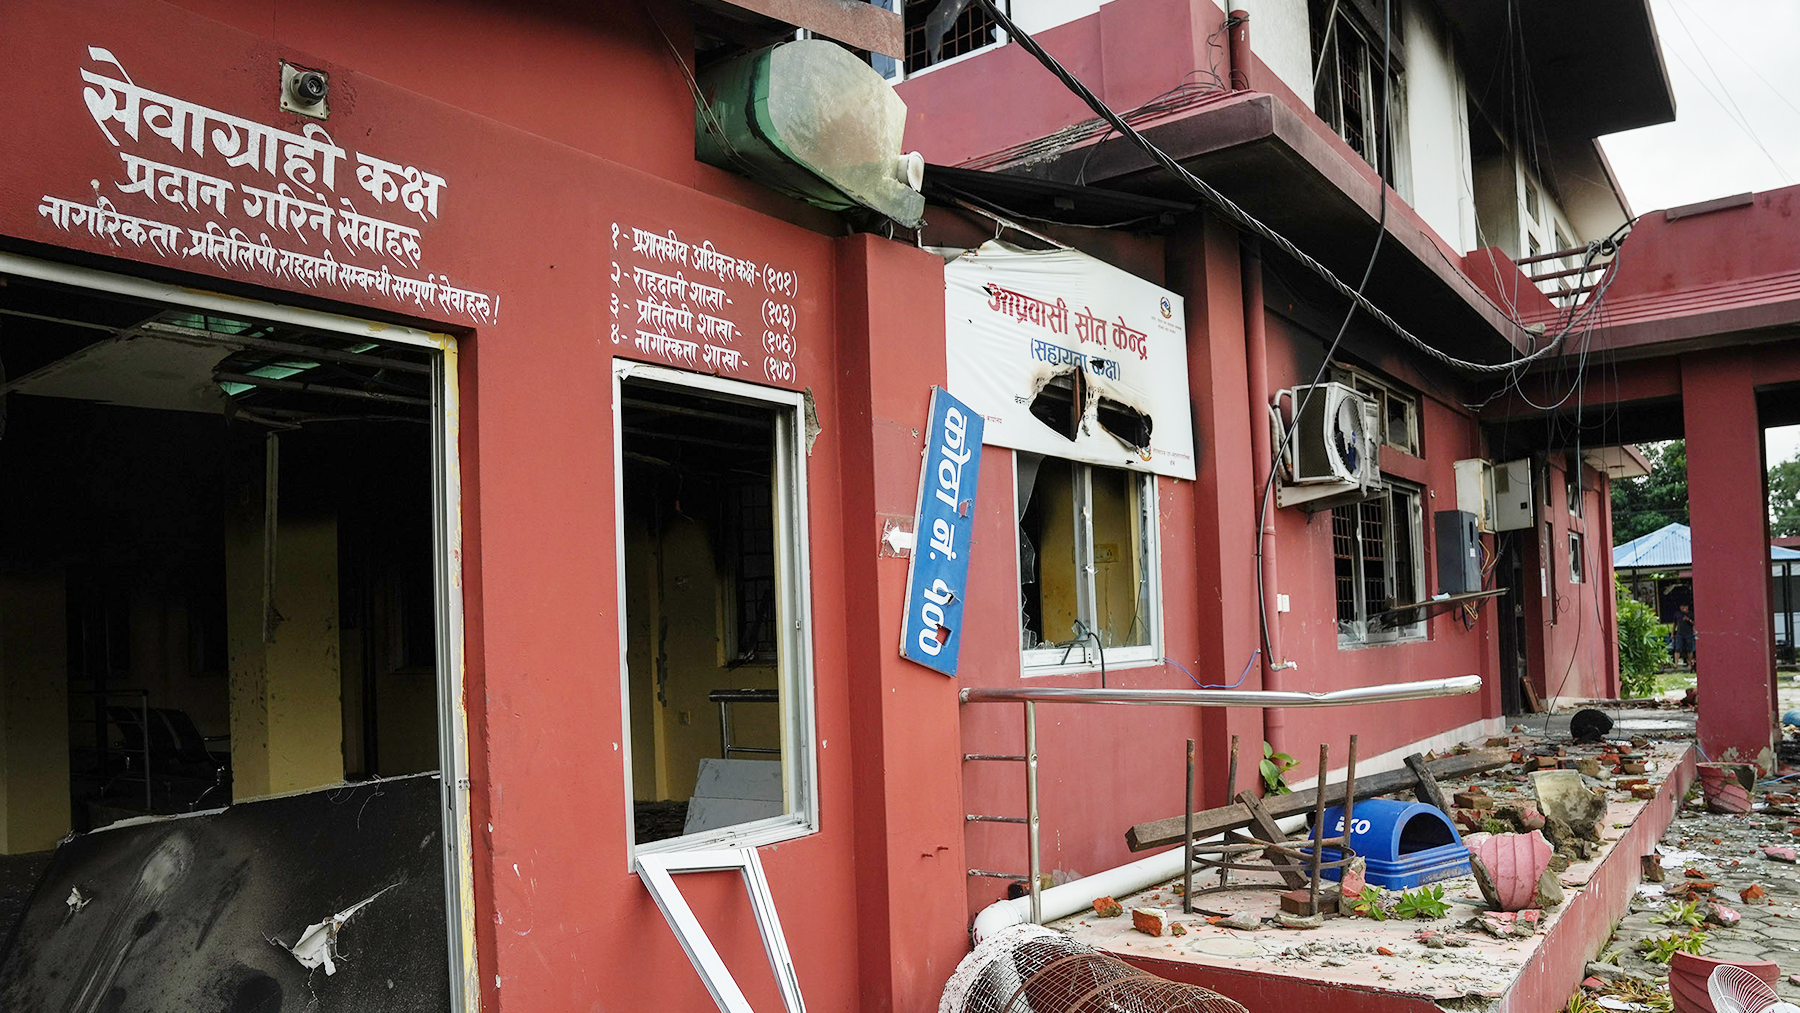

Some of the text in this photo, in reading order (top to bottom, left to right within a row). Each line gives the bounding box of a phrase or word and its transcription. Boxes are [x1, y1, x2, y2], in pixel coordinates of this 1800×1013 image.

[80, 45, 448, 220] सेवाग्राही कक्ष
[114, 151, 235, 217] प्रदान
[242, 181, 333, 244] गरिने
[279, 249, 339, 289] राहदानी
[391, 273, 438, 312] सम्पूर्ण
[632, 227, 690, 268] प्रशासकीय
[691, 240, 736, 282] अधिकृत
[633, 266, 688, 302] राहदानी
[634, 328, 699, 368] नागरिकता
[636, 295, 694, 336] प्रतिलिपी
[987, 282, 1069, 335] आप्रवासी
[1112, 316, 1148, 361] केन्द्र
[935, 406, 971, 512] कोठा
[918, 578, 955, 656] १००
